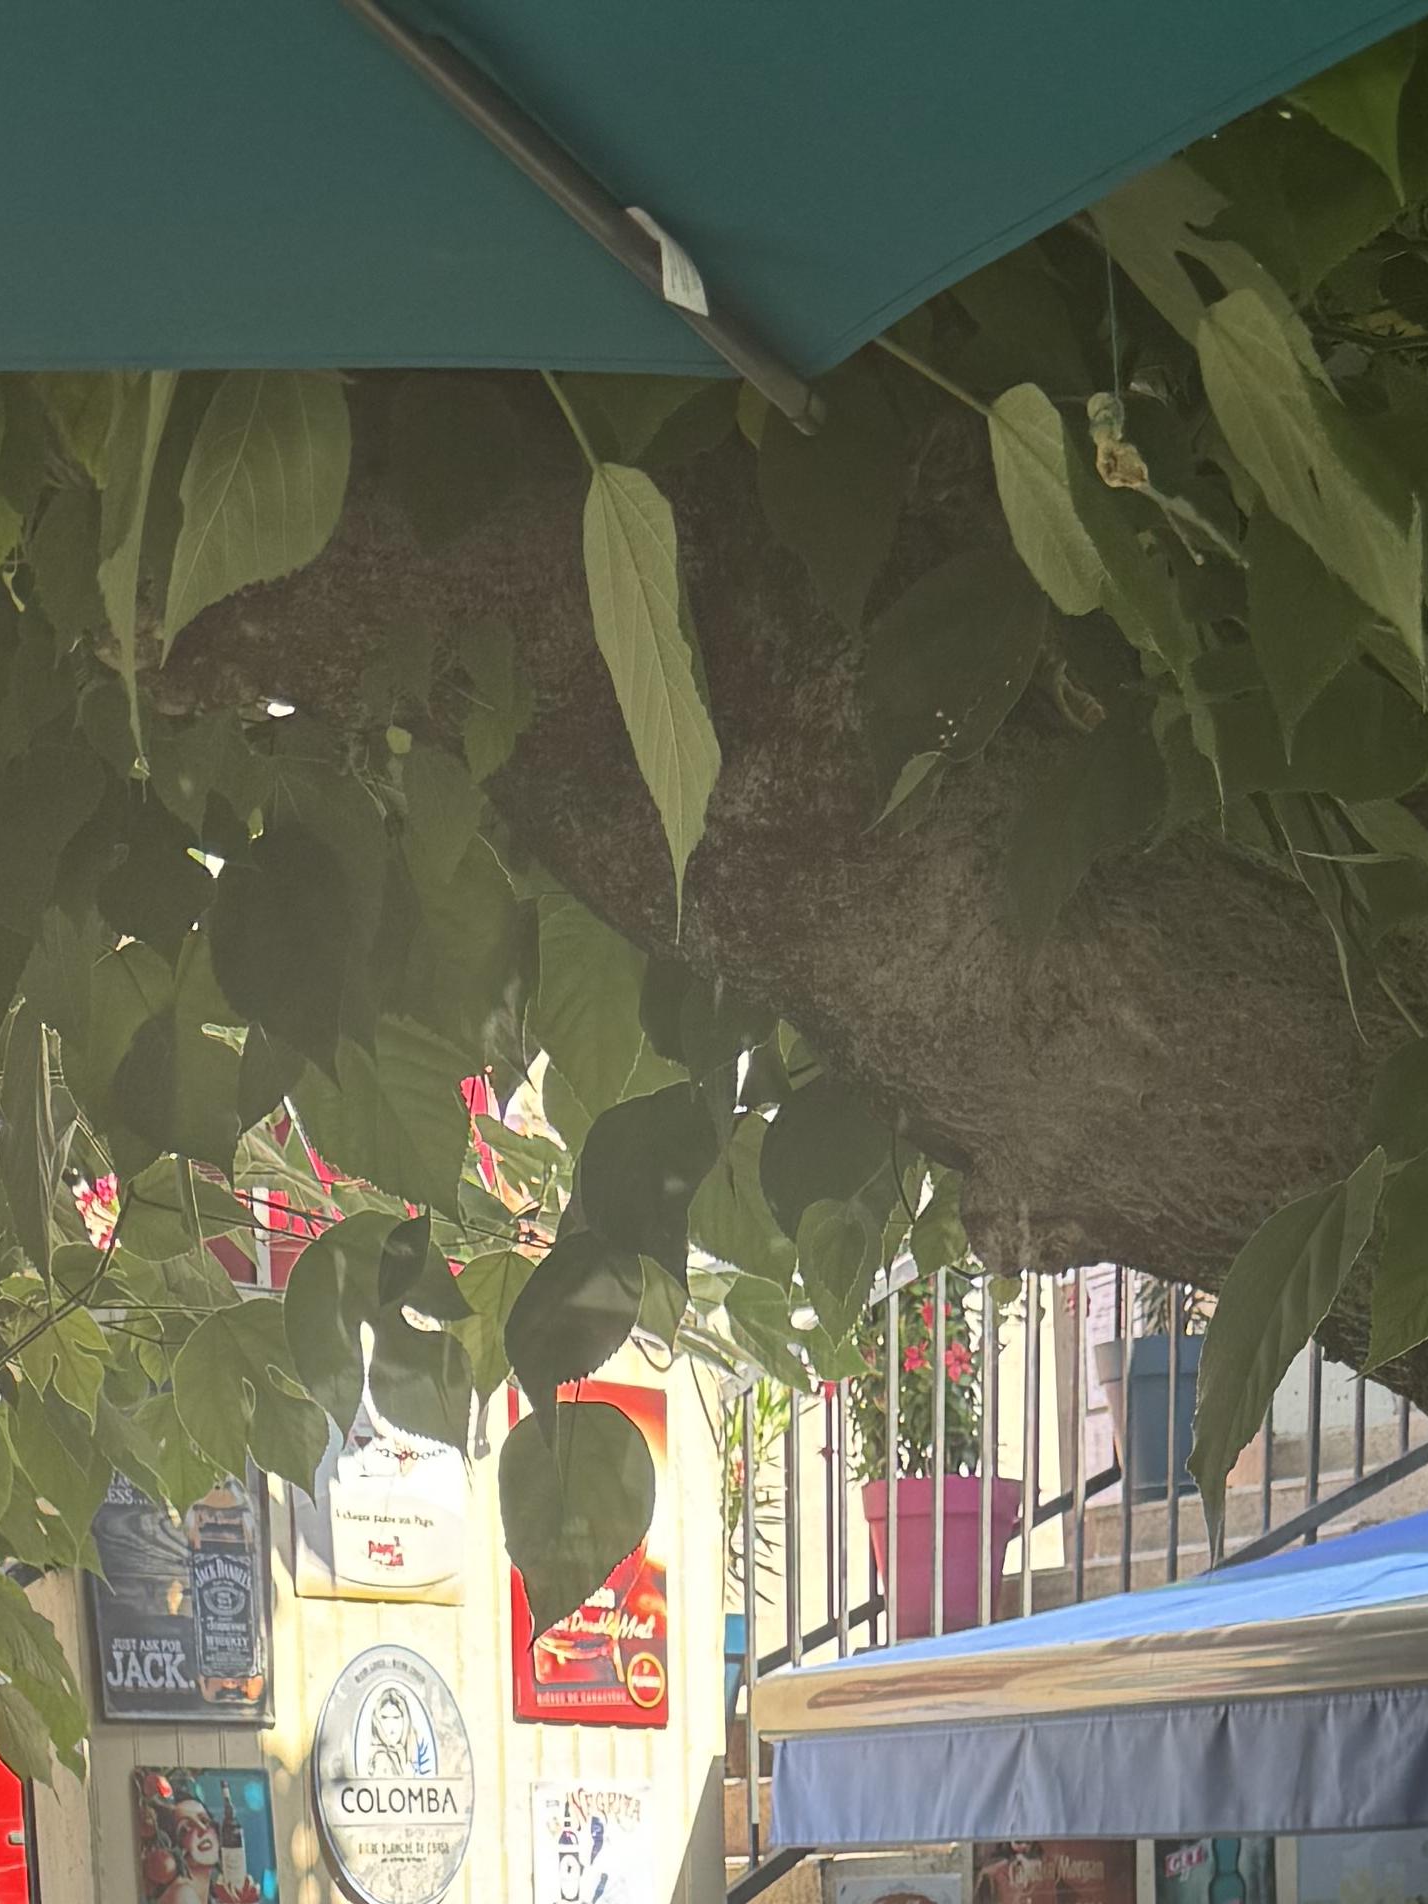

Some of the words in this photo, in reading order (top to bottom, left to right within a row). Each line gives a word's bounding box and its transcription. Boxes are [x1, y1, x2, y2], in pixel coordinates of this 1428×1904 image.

[112, 1637, 137, 1651] JUST
[140, 1637, 160, 1651] ASK
[162, 1638, 182, 1652] FOR
[107, 1651, 196, 1689] JACK.
[341, 1787, 458, 1814] COLOMBA
